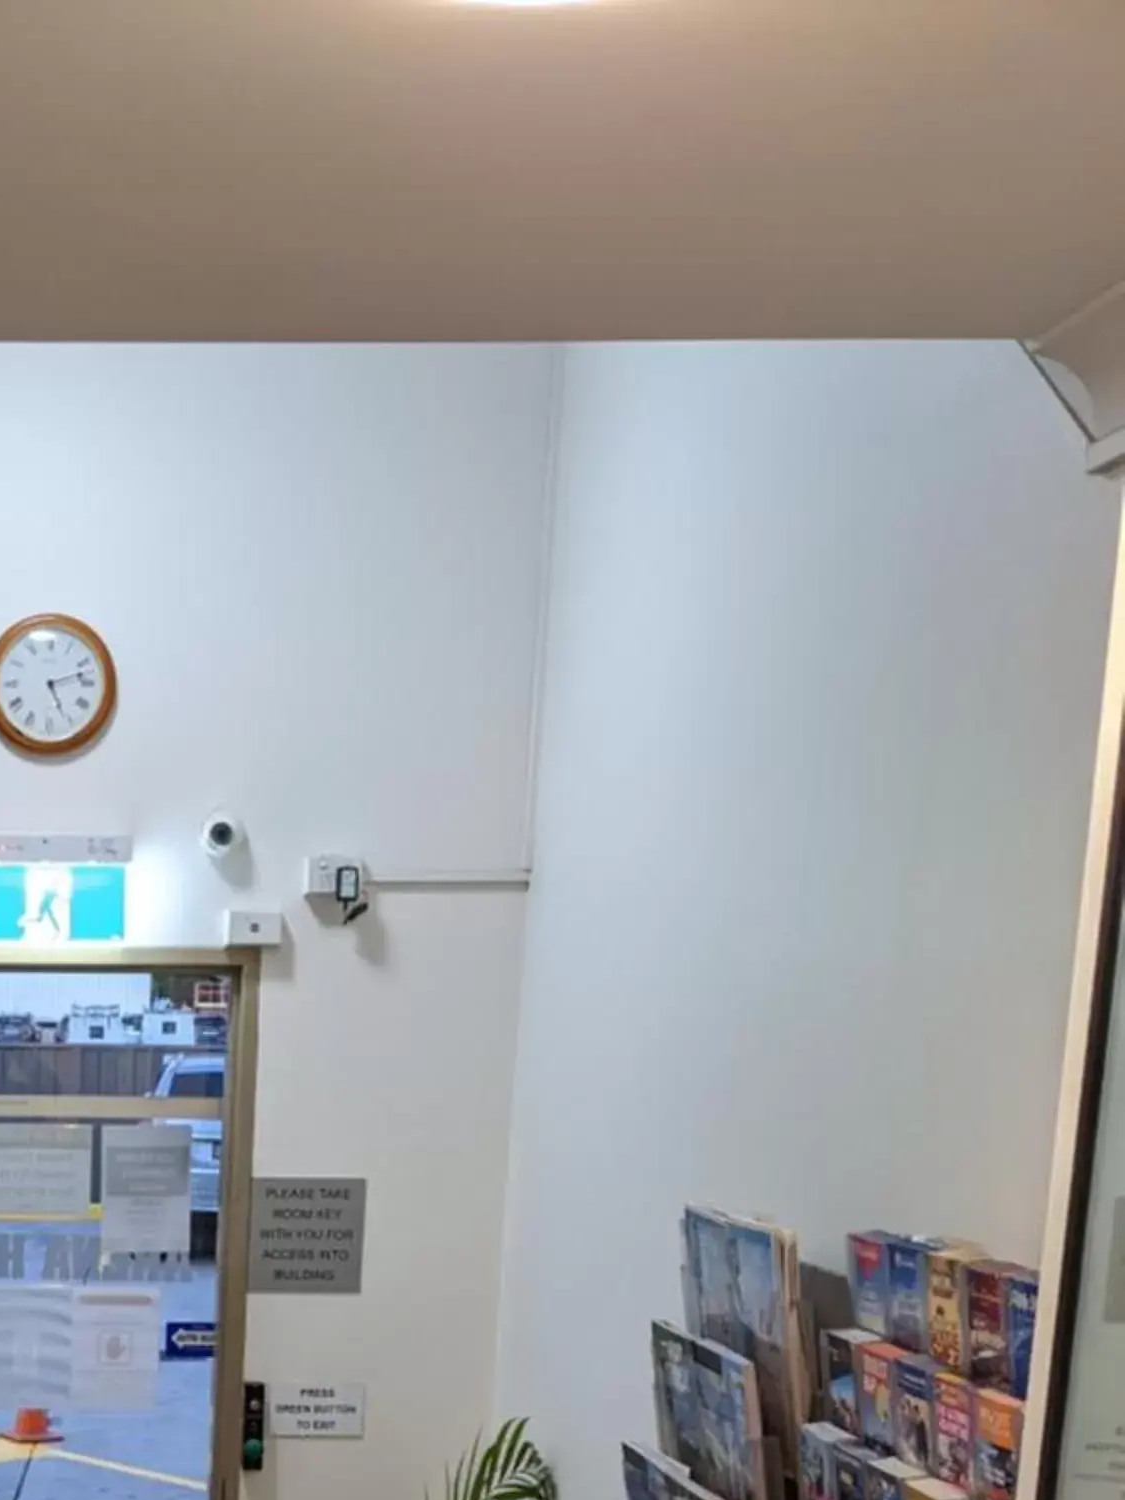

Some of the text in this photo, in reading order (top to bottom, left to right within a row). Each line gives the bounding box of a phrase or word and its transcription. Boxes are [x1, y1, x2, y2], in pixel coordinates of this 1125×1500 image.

[264, 1187, 351, 1201] PLEASE TAKE
[272, 1207, 343, 1221] ROOM KEY
[259, 1227, 354, 1241] WITH YOU FOR
[262, 1248, 350, 1262] ACCESS INTO
[272, 1267, 335, 1281] BUILDING
[299, 1386, 336, 1400] PRESS
[274, 1402, 357, 1415] GREEN BUTTON
[296, 1419, 336, 1431] TO EXIT
